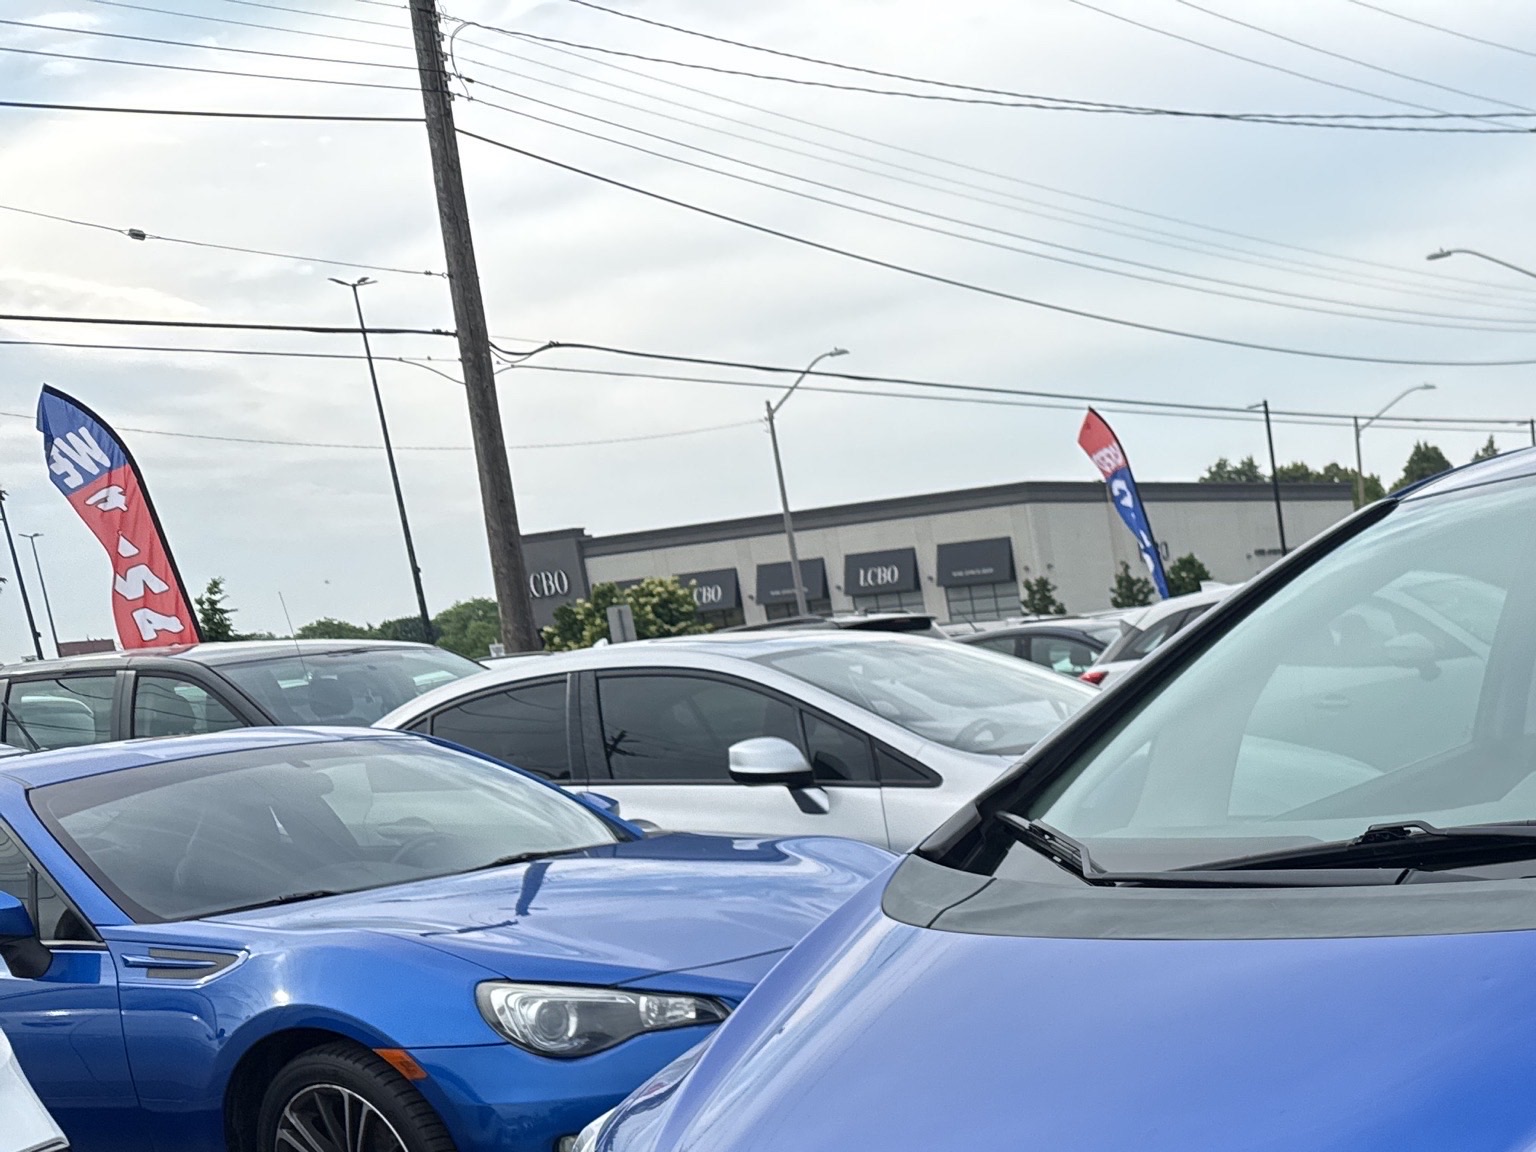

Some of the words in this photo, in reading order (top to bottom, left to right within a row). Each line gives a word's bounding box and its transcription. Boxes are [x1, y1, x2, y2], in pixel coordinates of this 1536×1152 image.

[529, 569, 568, 598] CBO
[858, 564, 899, 587] LCBO
[693, 585, 722, 606] CBO
